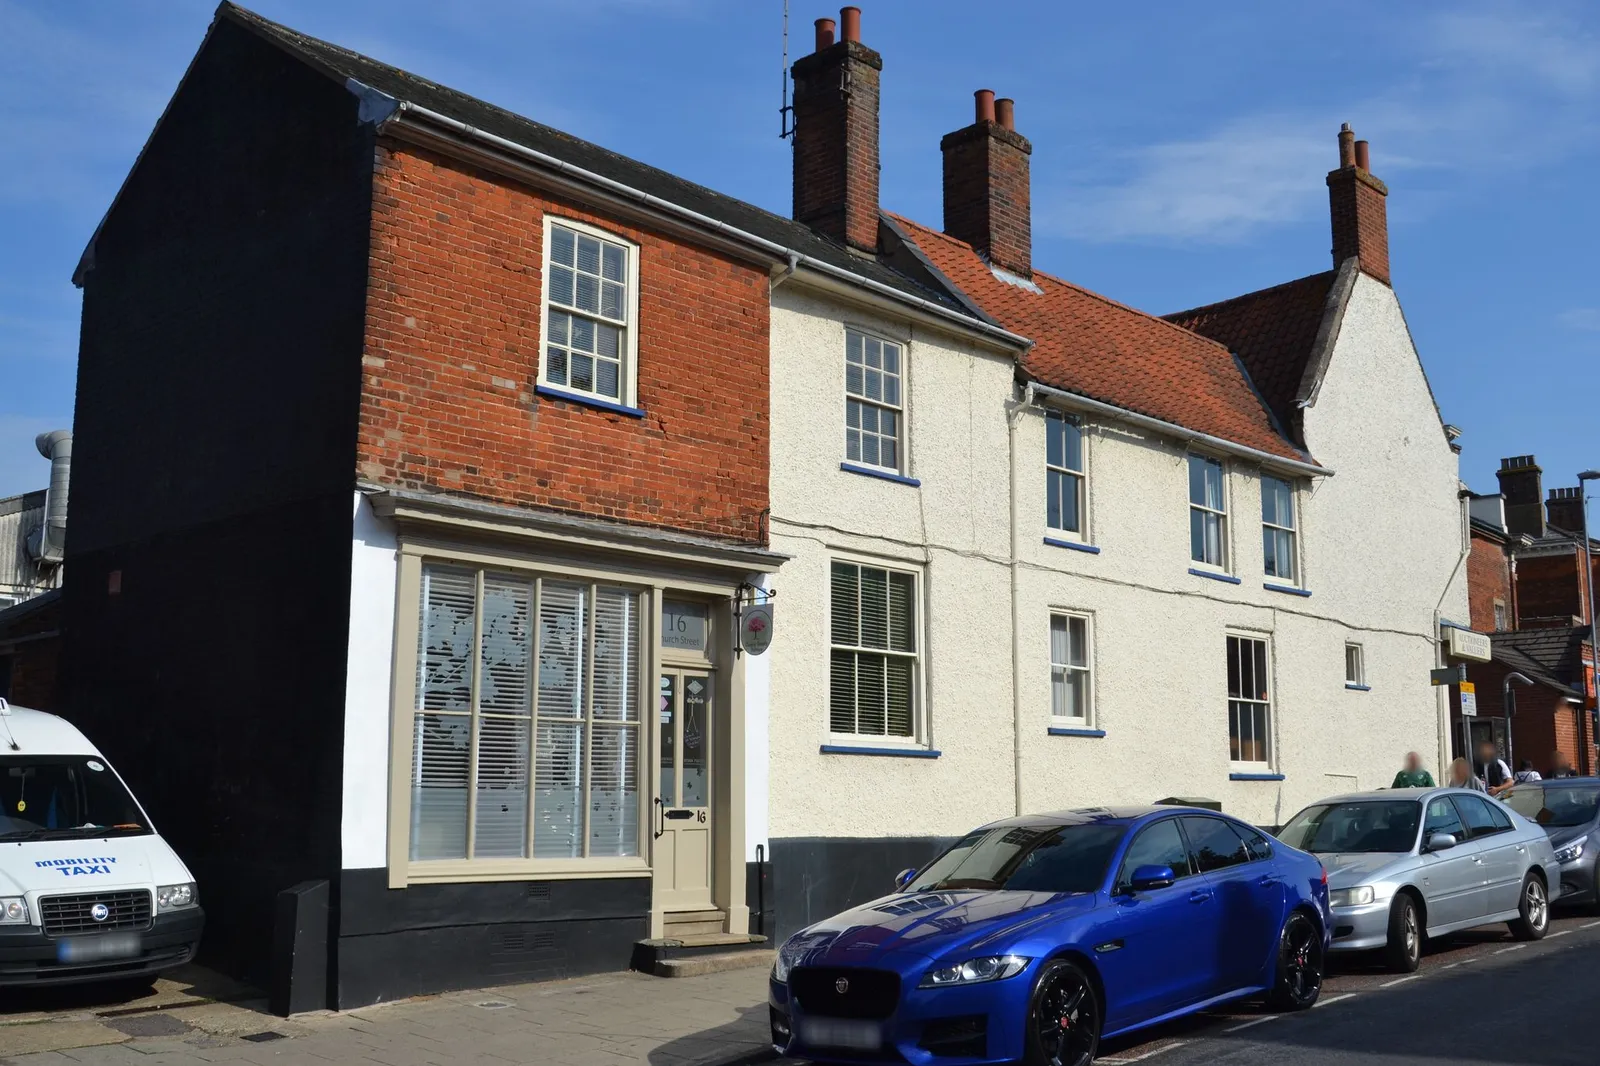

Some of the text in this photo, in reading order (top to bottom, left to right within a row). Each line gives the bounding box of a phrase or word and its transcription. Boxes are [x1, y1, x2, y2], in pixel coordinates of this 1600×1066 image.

[669, 612, 687, 633] 16
[662, 635, 700, 646] hurch Street
[697, 810, 706, 824] 16
[35, 857, 116, 868] MOBILITY
[56, 865, 111, 876] TAXI
